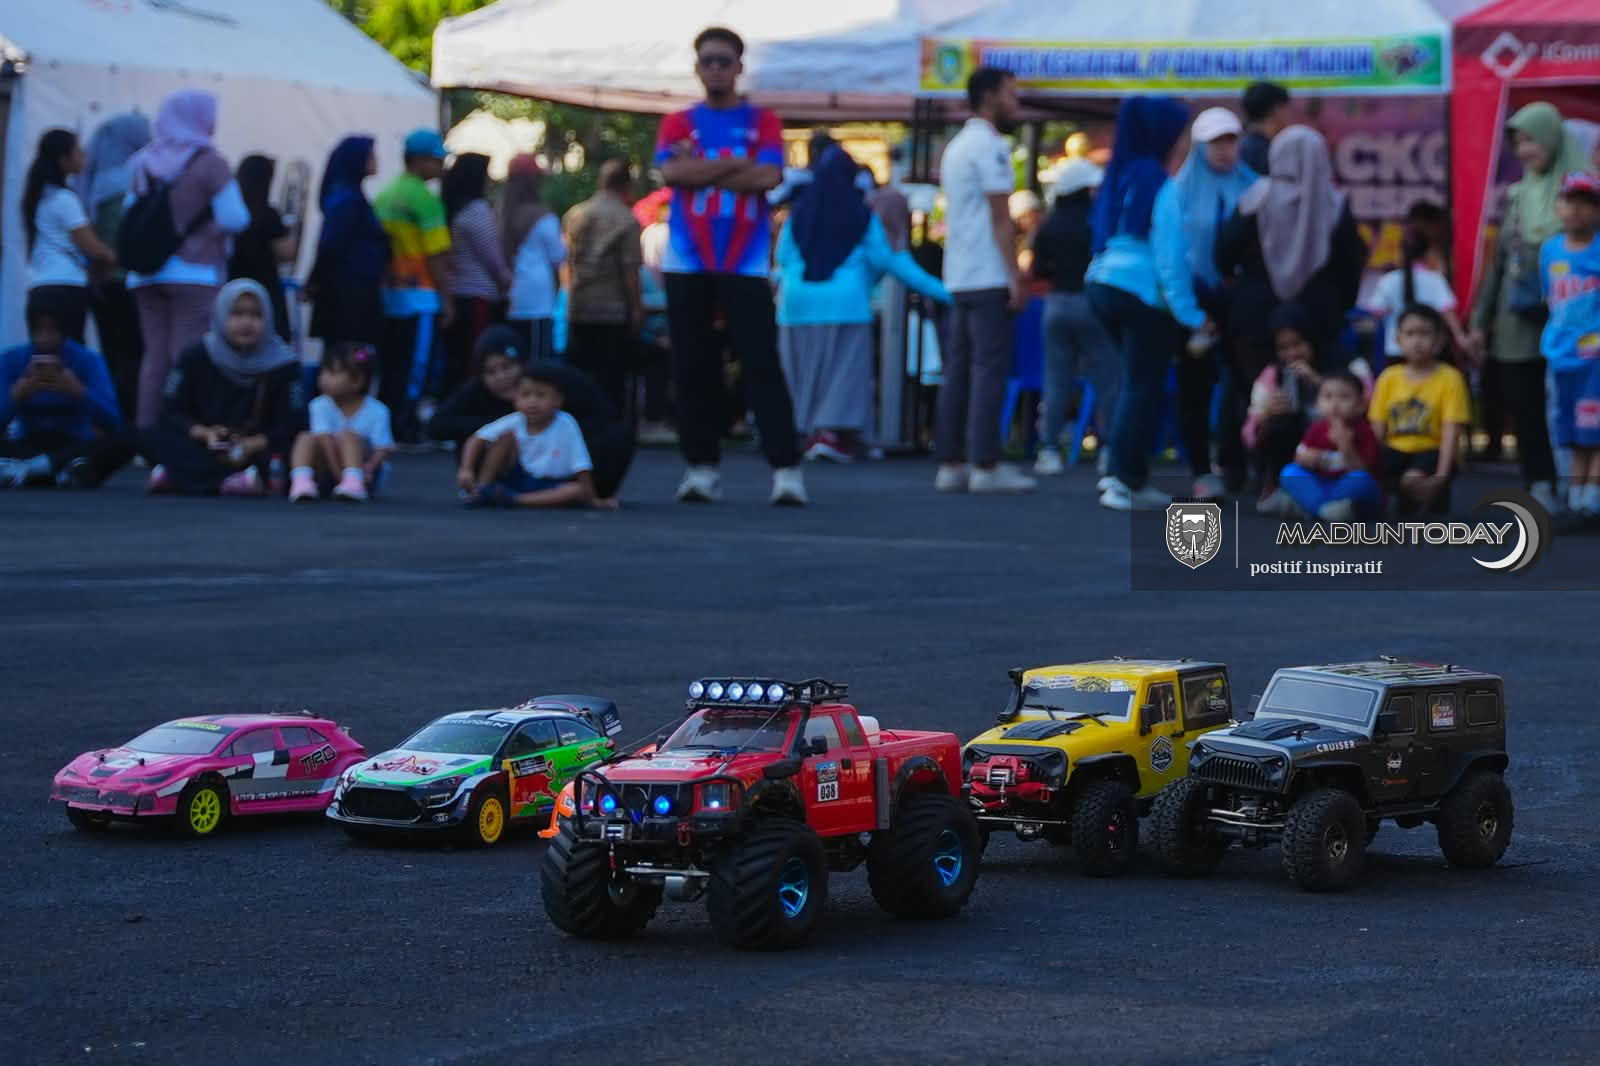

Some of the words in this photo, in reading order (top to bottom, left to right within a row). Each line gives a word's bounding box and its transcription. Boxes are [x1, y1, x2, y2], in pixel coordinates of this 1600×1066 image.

[1315, 739, 1356, 753] CRUISER
[300, 744, 337, 775] TRD
[819, 783, 836, 800] 038
